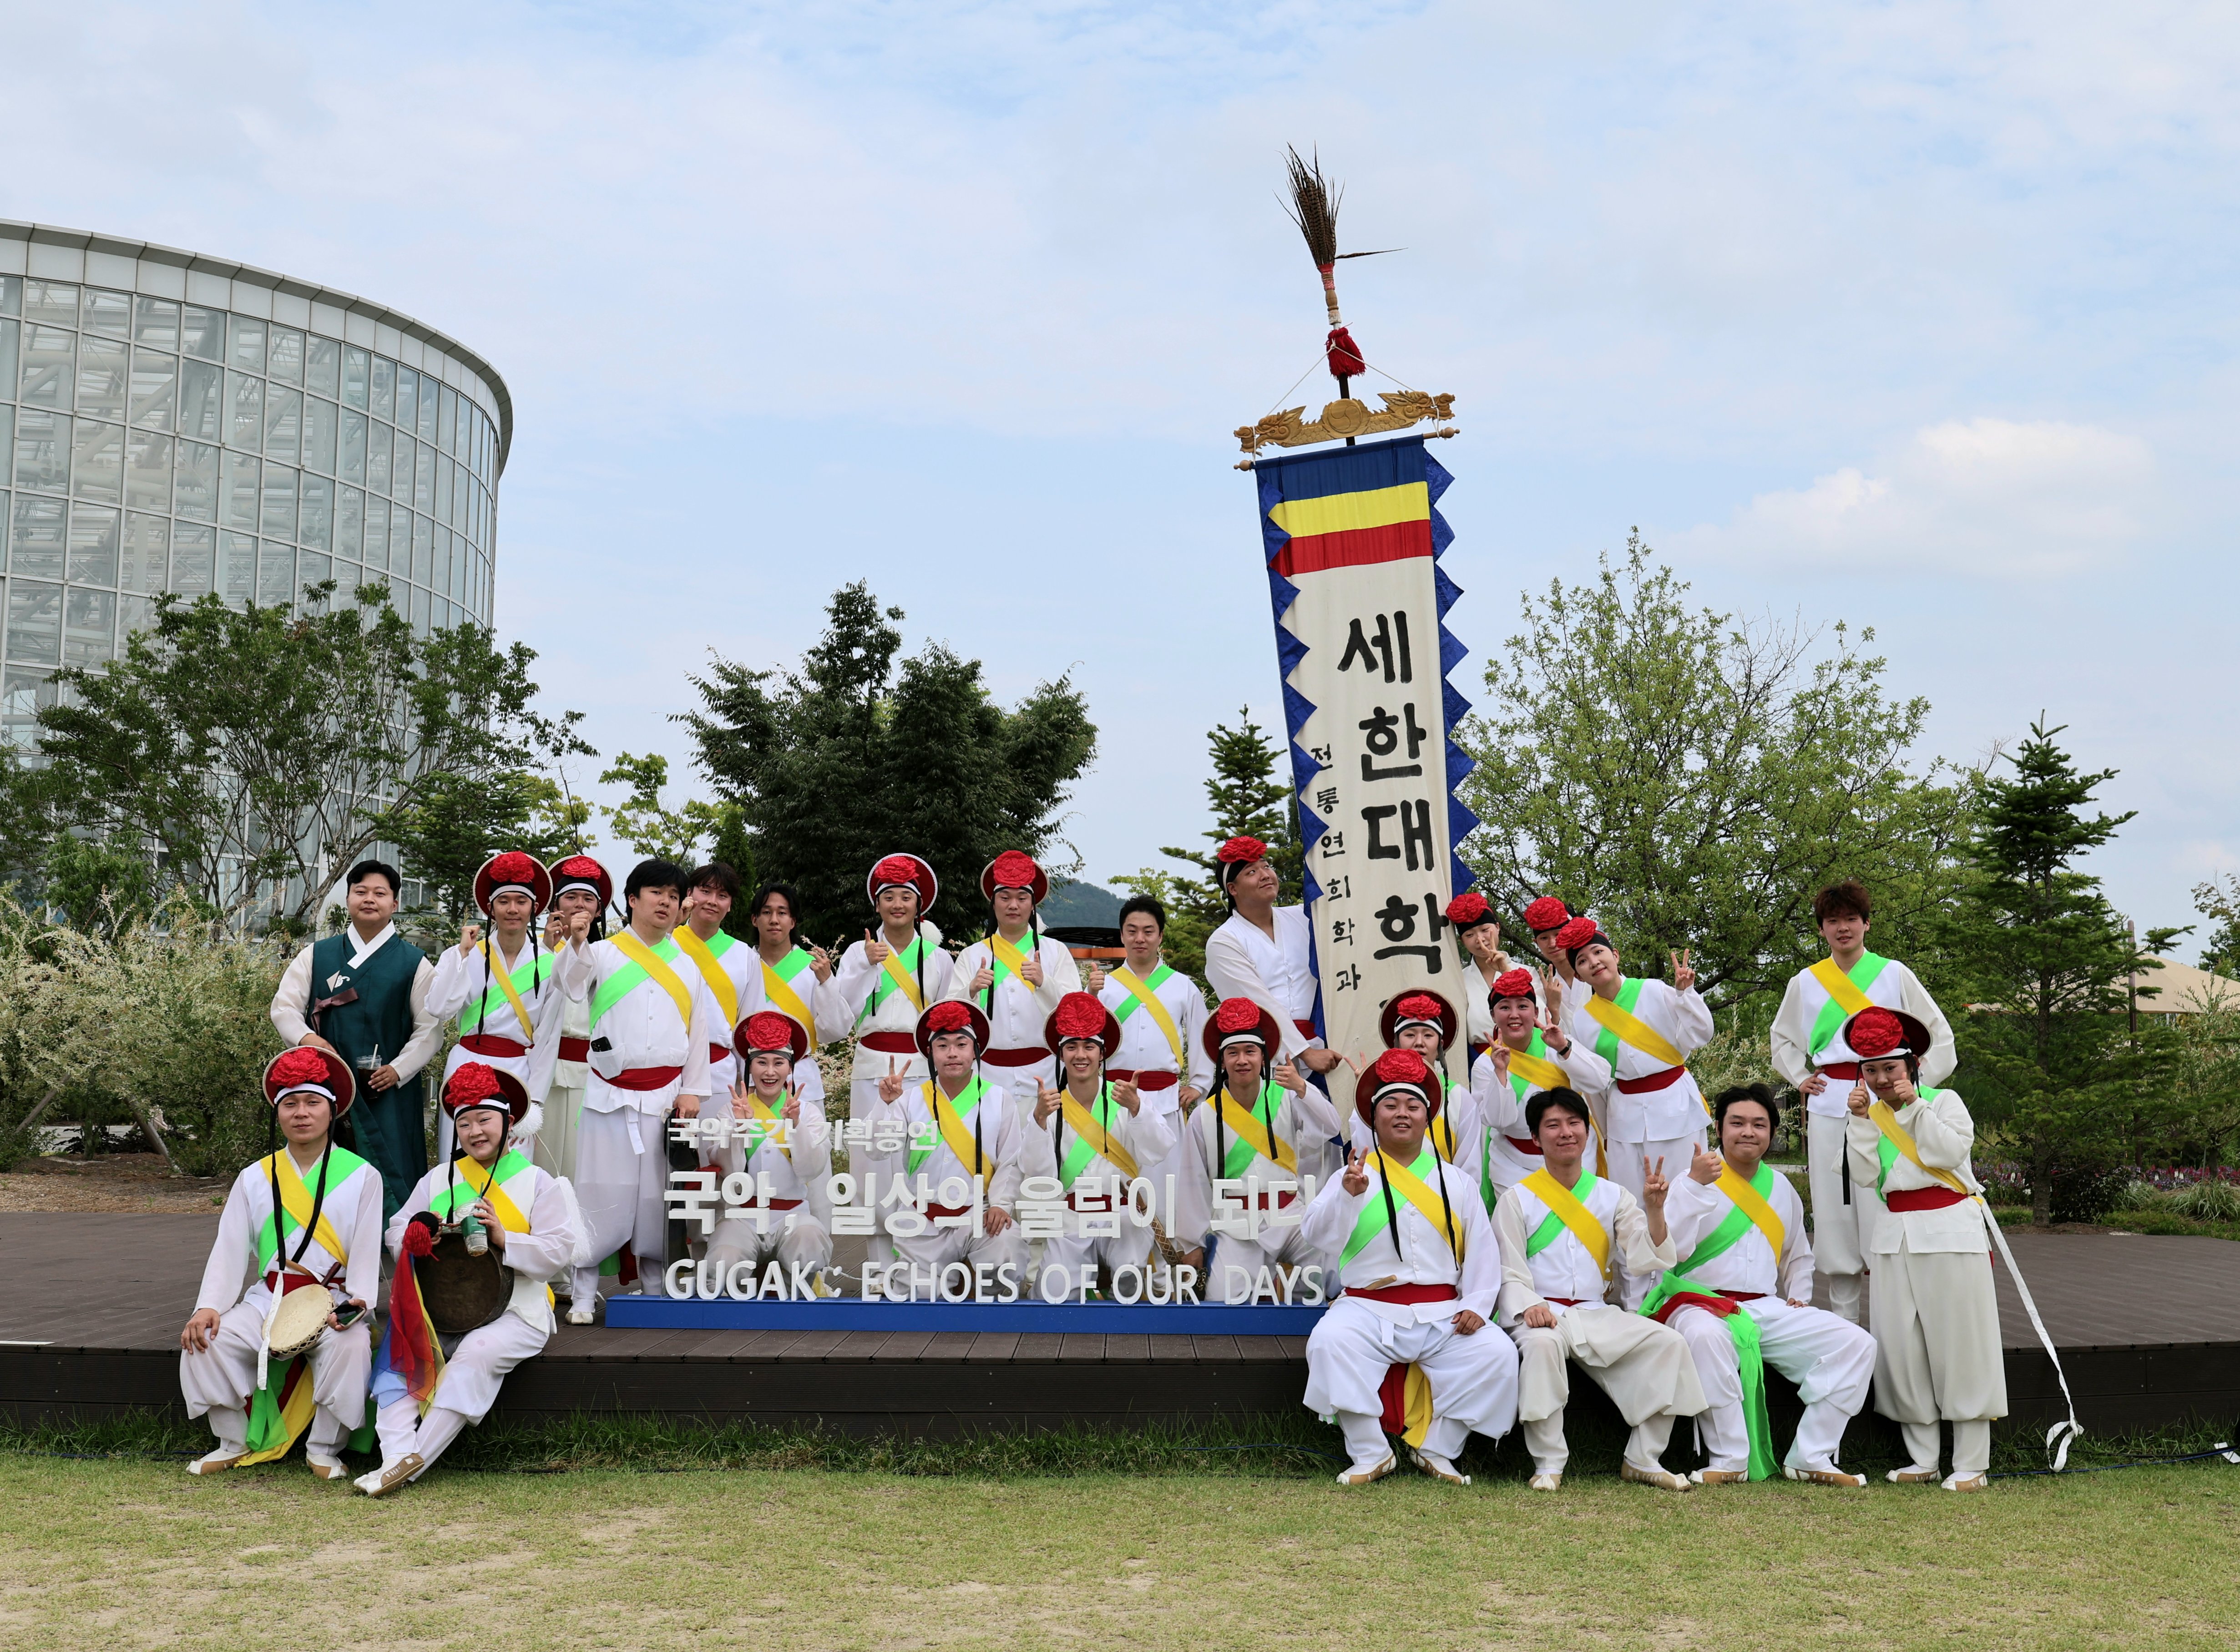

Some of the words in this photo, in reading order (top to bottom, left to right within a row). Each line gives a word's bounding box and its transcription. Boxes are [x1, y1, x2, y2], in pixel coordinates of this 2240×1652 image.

[1337, 611, 1449, 1009] 세한대학
[1310, 743, 1361, 992] 전통연희학과
[668, 1118, 796, 1148] 국악주간
[814, 1119, 938, 1151] 기획공연
[664, 1171, 798, 1235] 국악,
[826, 1172, 984, 1238] 일상의
[1015, 1174, 1175, 1238] 울림이
[665, 1258, 818, 1301] GUGAK
[862, 1262, 1019, 1303] ECHOES
[1040, 1263, 1098, 1304] OF
[1112, 1264, 1200, 1305] OUR
[1224, 1265, 1323, 1306] DAYS
